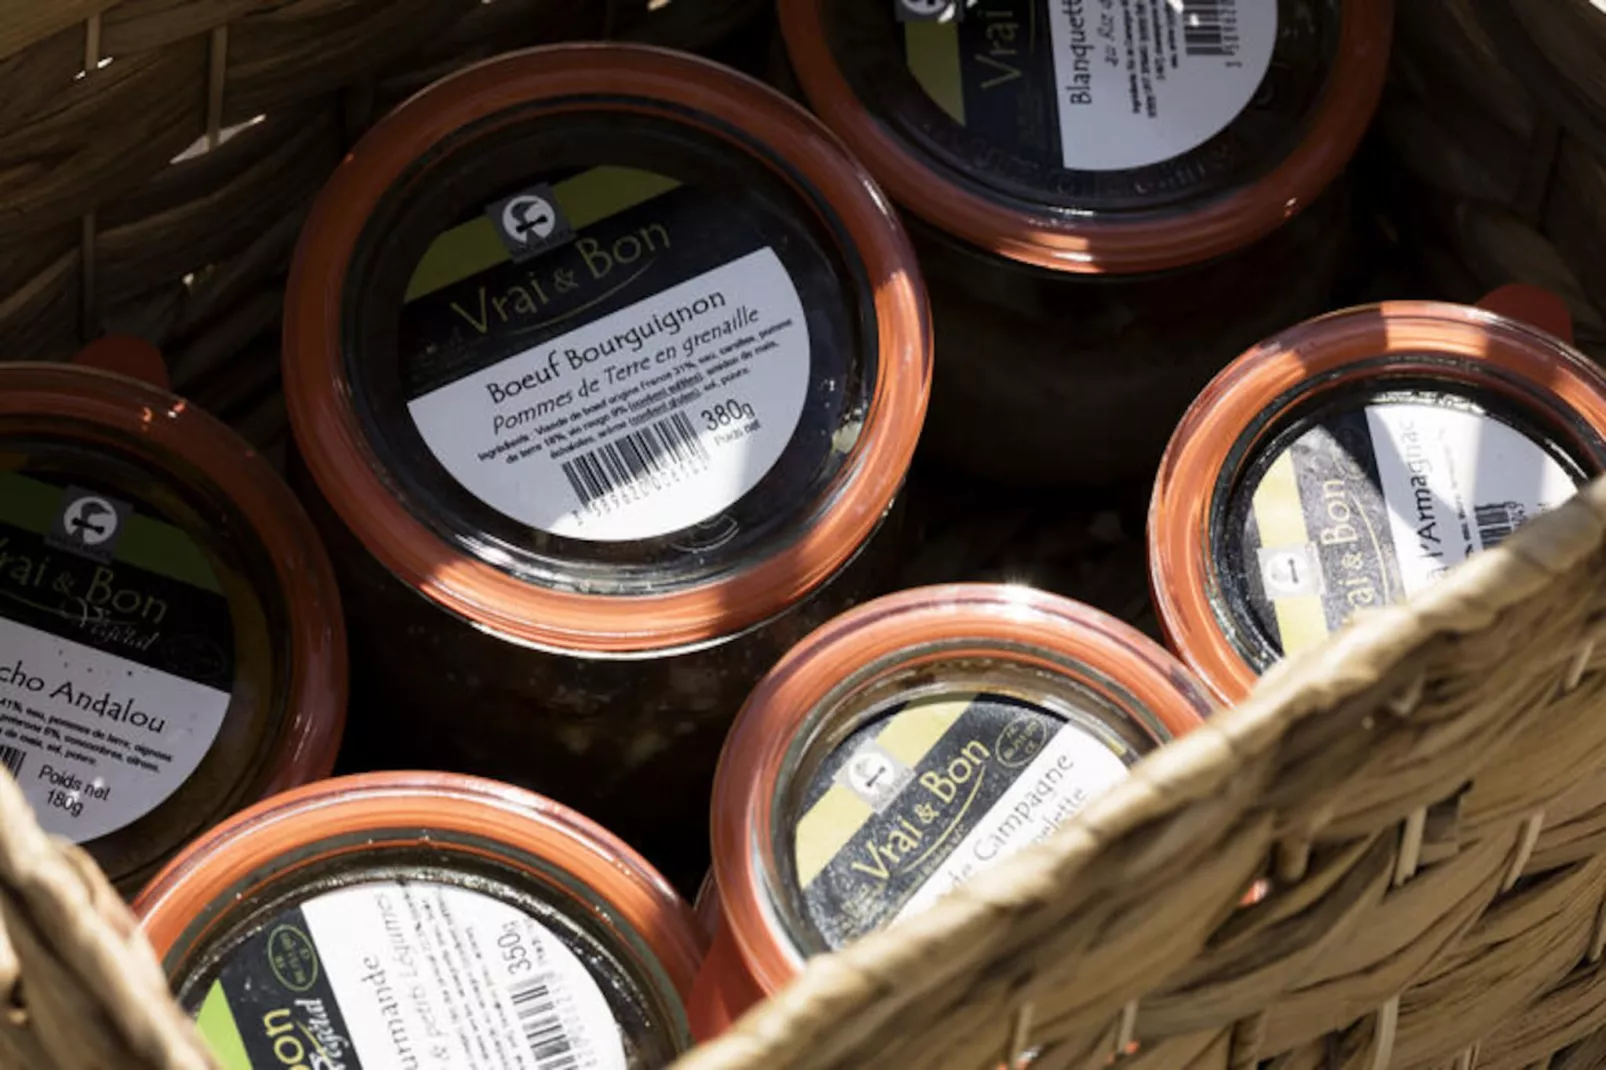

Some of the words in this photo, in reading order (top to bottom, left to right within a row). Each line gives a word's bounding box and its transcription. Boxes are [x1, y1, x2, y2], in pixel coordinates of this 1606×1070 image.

[974, 11, 1023, 90] Vrai
[451, 272, 550, 334] Vrai
[554, 269, 580, 293] &
[575, 224, 671, 280] Bon
[486, 350, 560, 404] Boeuf
[564, 292, 726, 370] Bourguignon
[493, 391, 573, 435] Pommes
[570, 368, 604, 400] de
[604, 357, 650, 385] Terre
[655, 346, 677, 364] en
[674, 305, 759, 358] grenaille
[700, 398, 755, 430] 380g
[1314, 480, 1358, 545] Bon
[0, 538, 50, 587] rai
[52, 572, 75, 596] &
[81, 566, 167, 624] Bon
[1342, 552, 1364, 570] &
[49, 681, 165, 733] Andalou
[38, 764, 82, 790] Poids
[47, 789, 84, 818] 180g
[919, 741, 990, 807] Bon
[914, 802, 940, 824] &
[851, 815, 923, 893] Vrai
[497, 921, 532, 975] 350g
[263, 1008, 315, 1070] on
